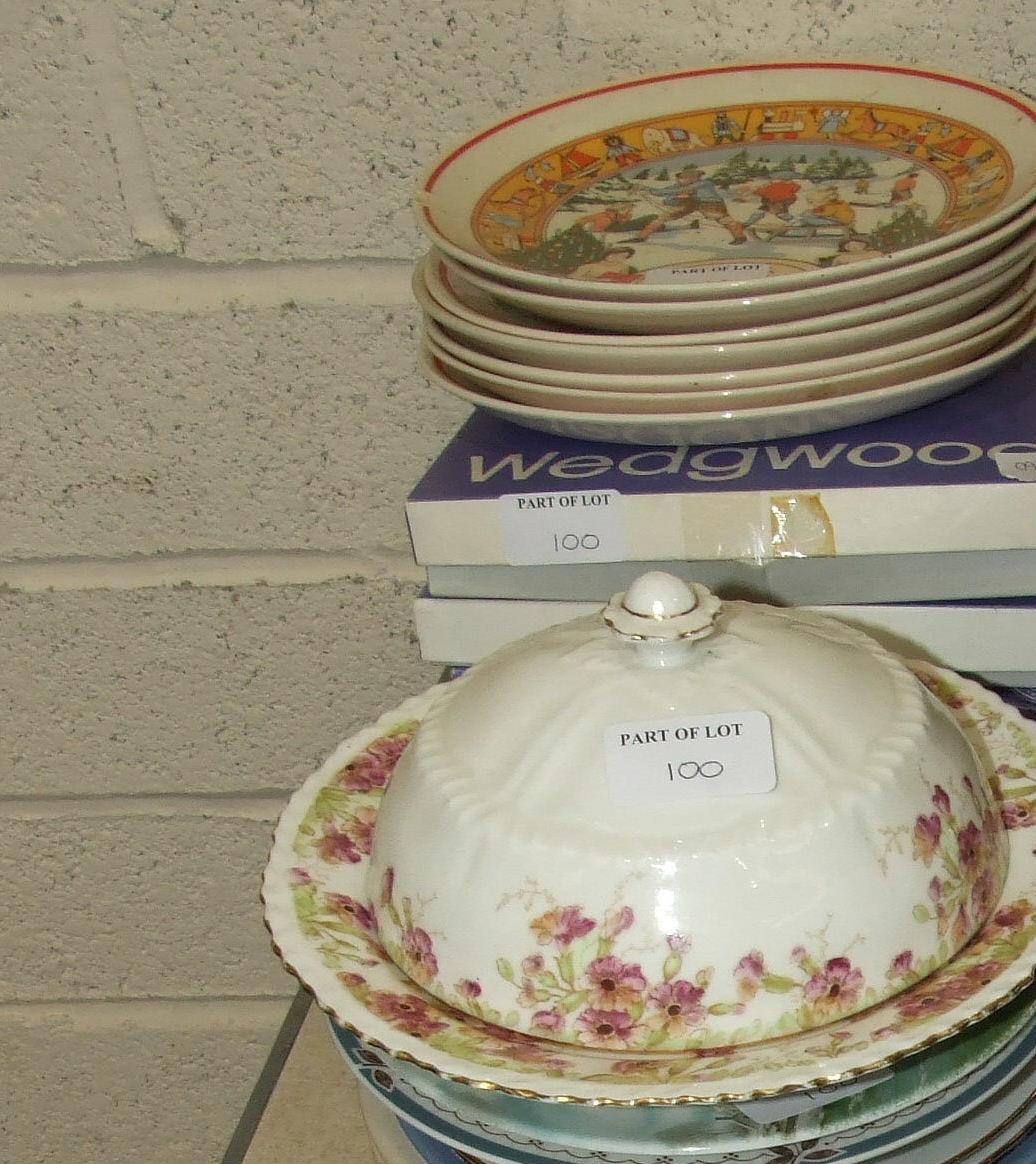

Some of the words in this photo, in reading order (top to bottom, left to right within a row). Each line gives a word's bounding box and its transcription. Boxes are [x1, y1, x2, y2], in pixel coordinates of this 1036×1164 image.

[671, 267, 706, 275] PART
[733, 263, 760, 271] LOT
[517, 495, 555, 510] PART
[559, 494, 579, 508] OF
[582, 493, 611, 507] LOT
[554, 533, 600, 552] 100
[620, 729, 669, 746] PART
[674, 726, 700, 741] OF
[704, 723, 743, 739] LOT
[667, 760, 724, 781] 100
